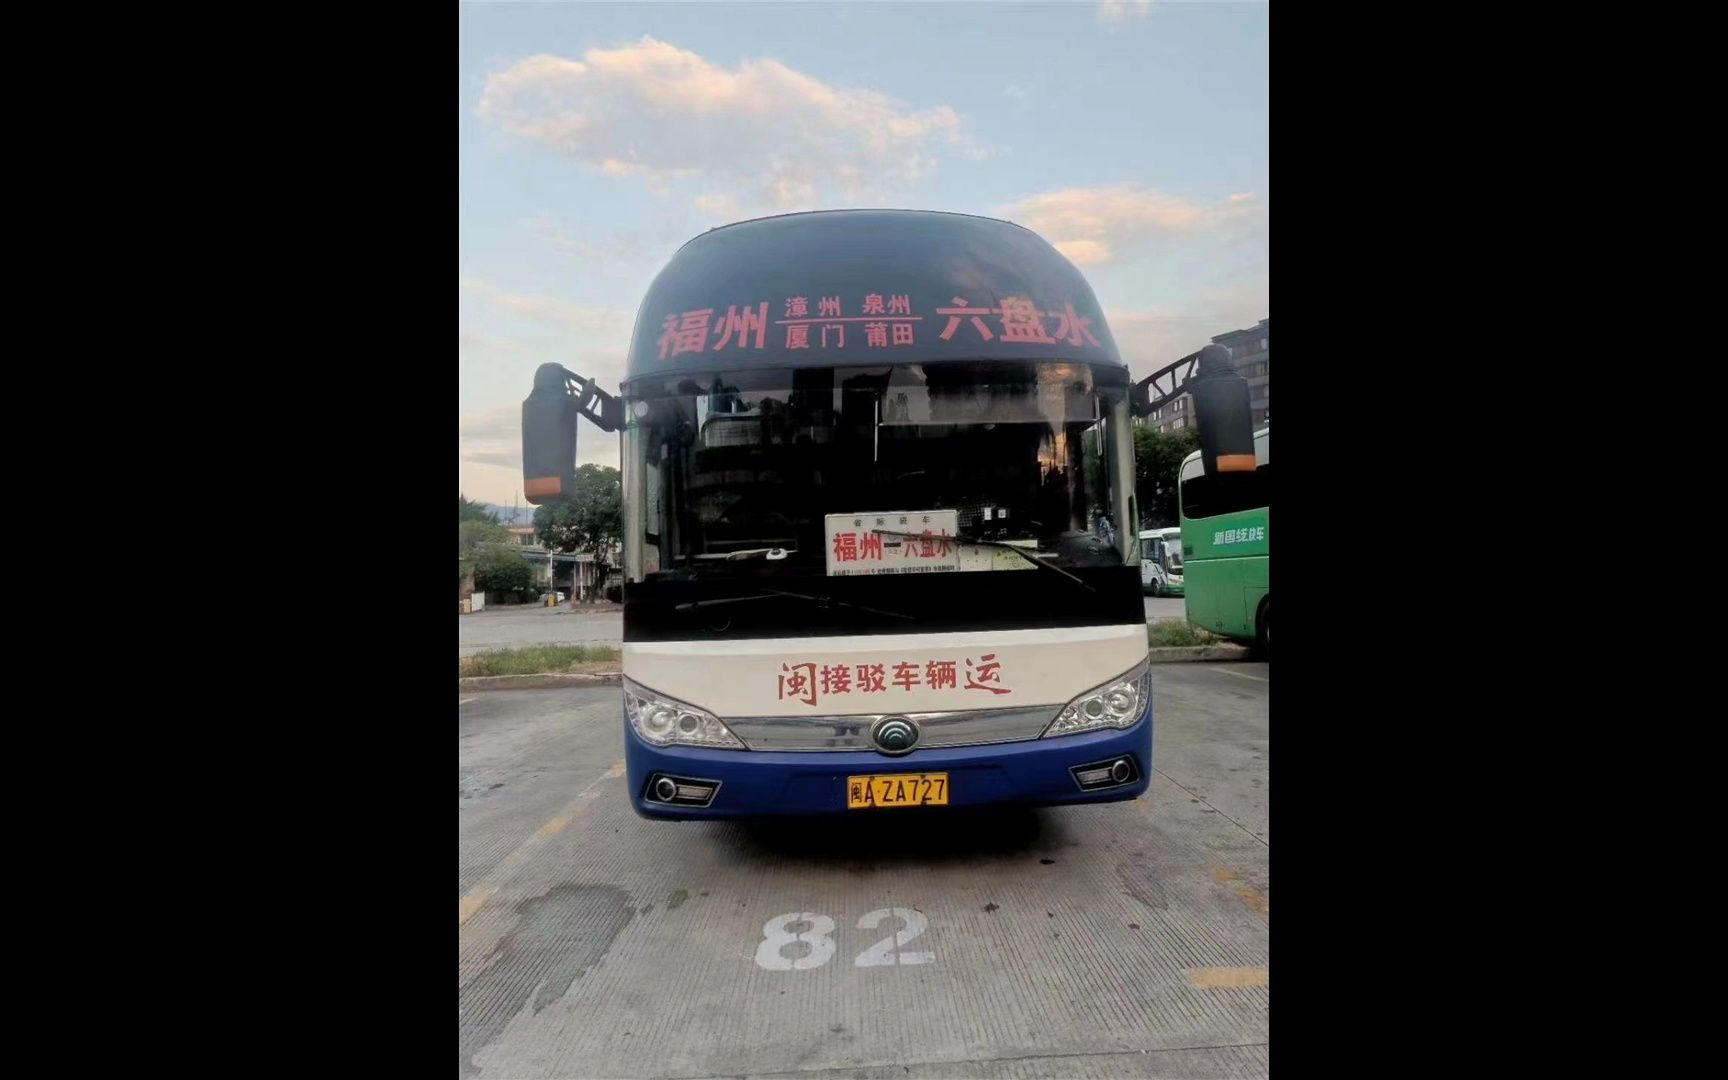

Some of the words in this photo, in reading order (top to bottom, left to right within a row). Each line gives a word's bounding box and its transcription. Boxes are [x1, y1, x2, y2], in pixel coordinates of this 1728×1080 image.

[657, 302, 769, 359] 福州
[785, 296, 841, 317] 漳州
[861, 294, 911, 317] 泉州
[936, 296, 1101, 348] 六盘水
[785, 323, 845, 349] 厦门
[865, 321, 914, 348] 莆田
[755, 907, 936, 970] 82
